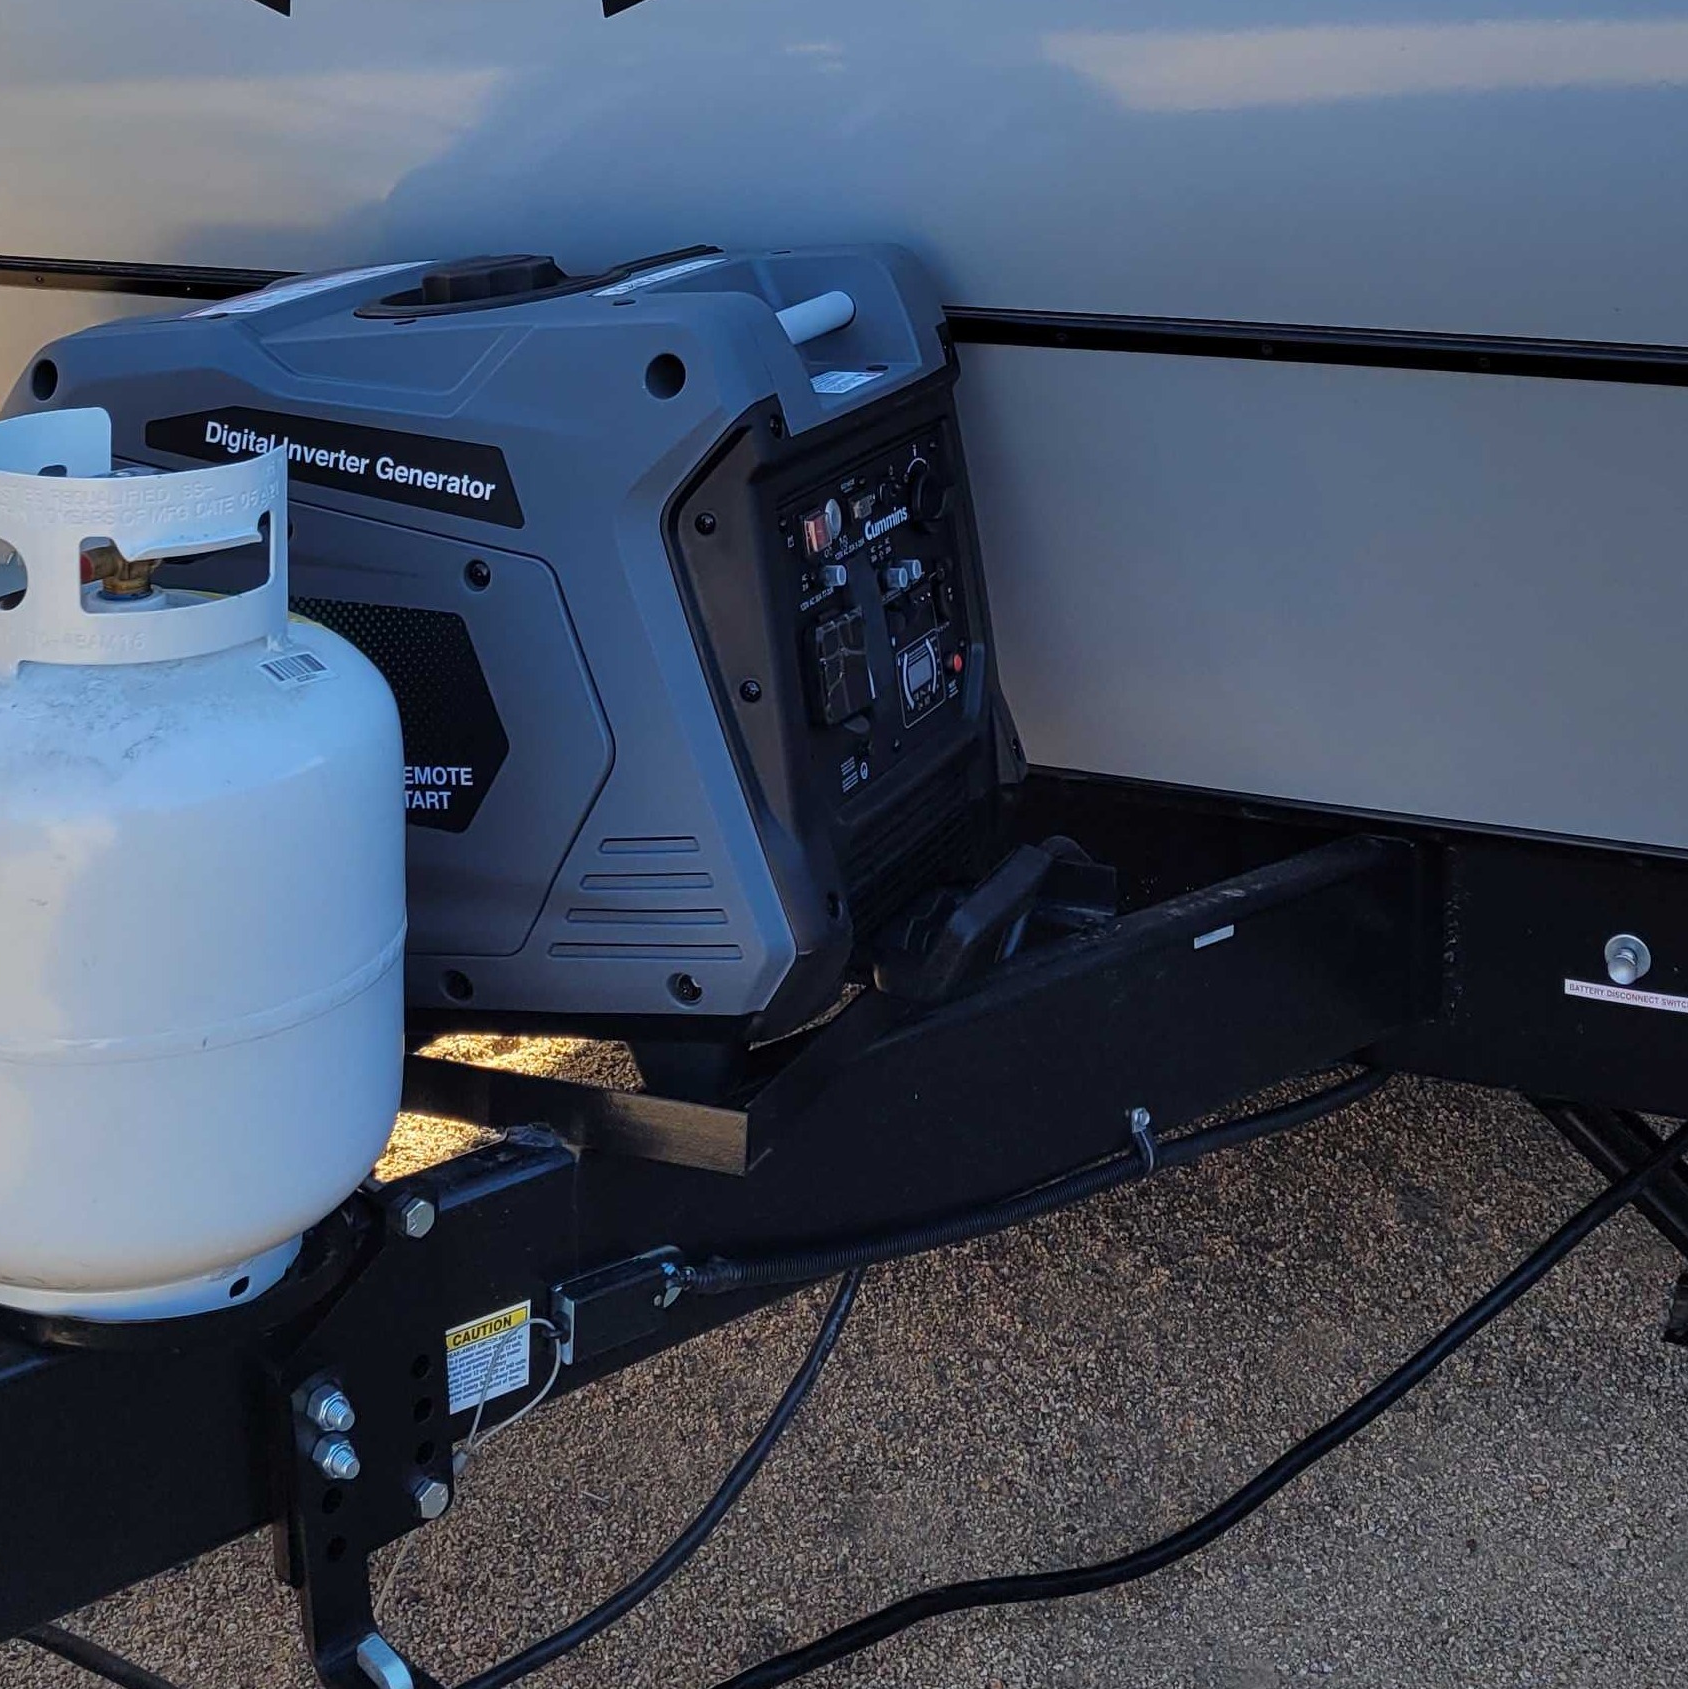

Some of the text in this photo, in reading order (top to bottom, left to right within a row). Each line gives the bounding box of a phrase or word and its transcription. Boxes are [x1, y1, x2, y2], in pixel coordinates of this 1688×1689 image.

[205, 420, 276, 454] Digital
[376, 456, 496, 501] Generator
[864, 506, 908, 541] Cummins
[404, 765, 473, 786] EMOTE
[404, 790, 452, 810] TART
[1569, 983, 1604, 996] BATTERY
[1606, 989, 1660, 1006] DISCONNECT
[452, 1315, 512, 1346] CAUTION
